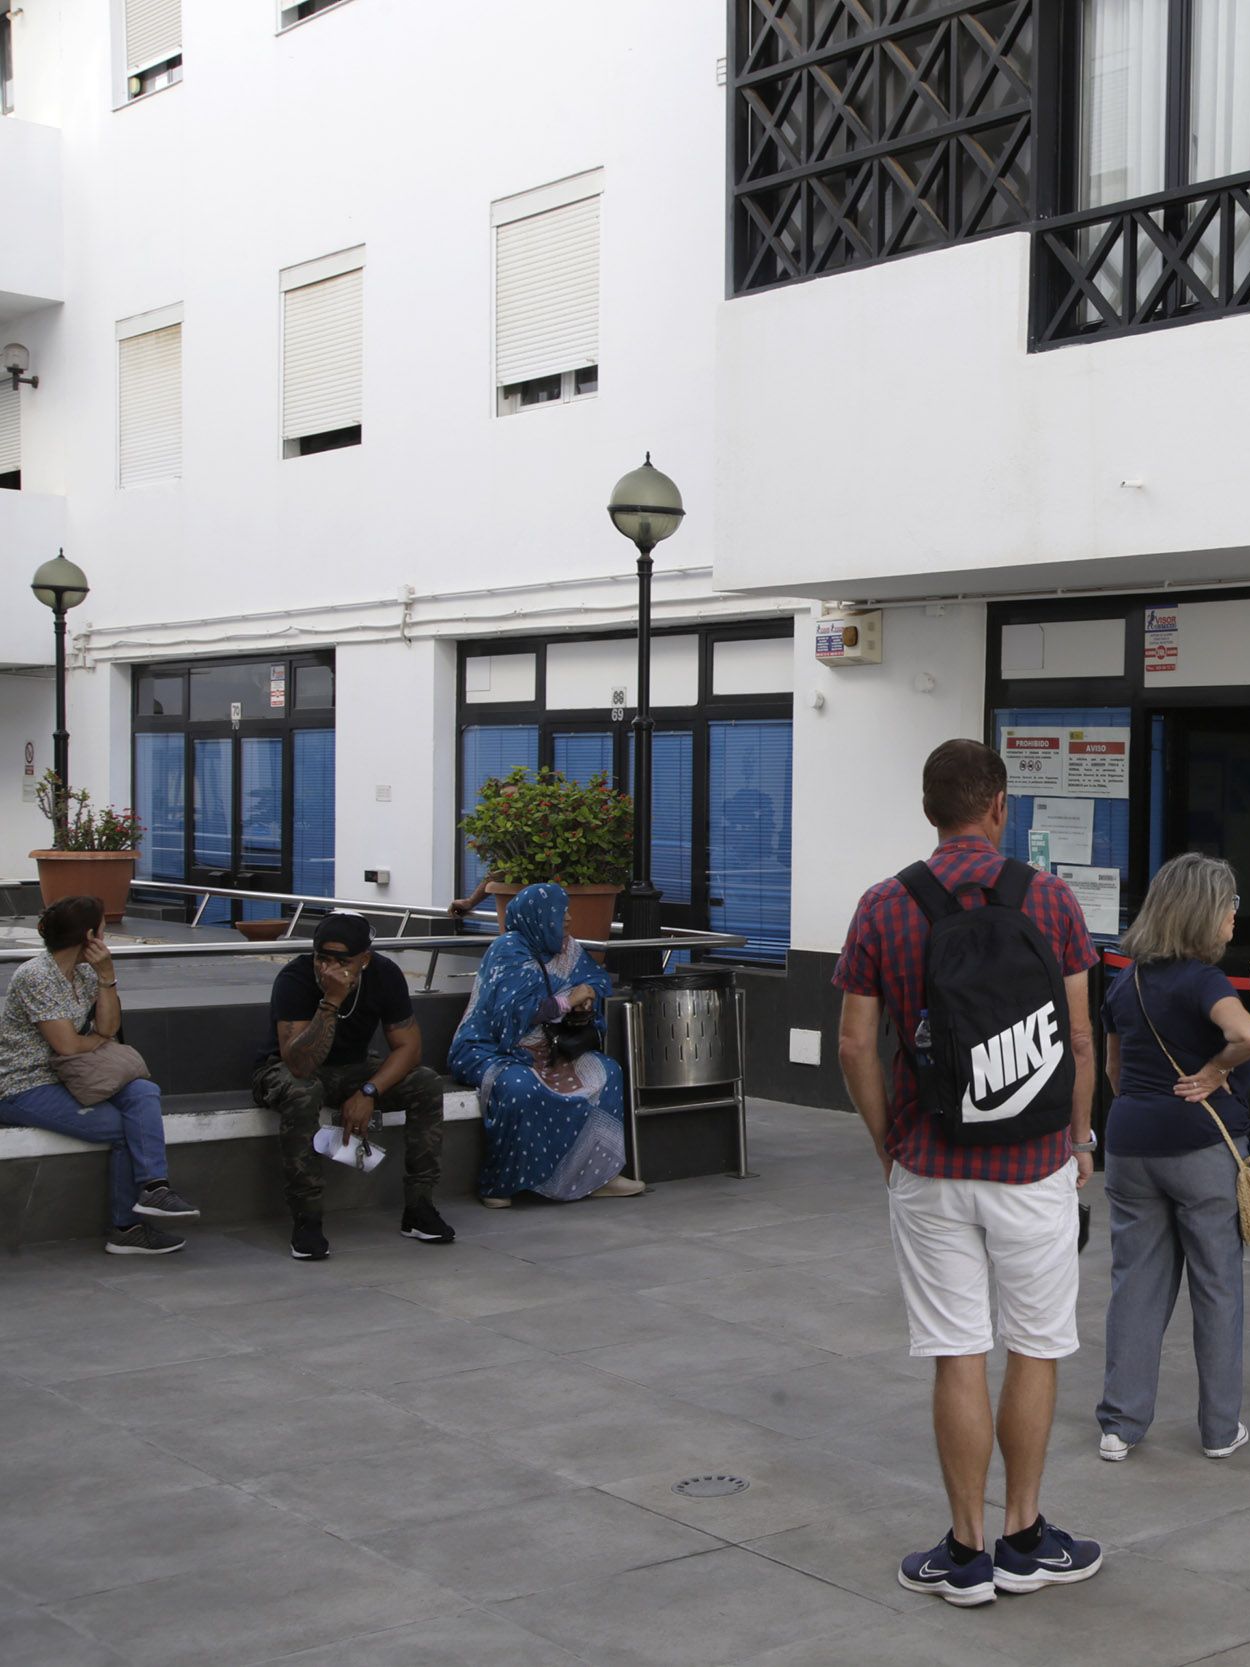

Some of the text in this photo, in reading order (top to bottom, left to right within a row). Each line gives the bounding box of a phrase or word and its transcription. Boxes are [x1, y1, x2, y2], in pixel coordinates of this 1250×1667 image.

[1155, 615, 1177, 625] VISOR
[611, 708, 624, 722] 69
[1015, 740, 1050, 748] PROHIBIDO
[1085, 744, 1107, 753] AVISO
[970, 1000, 1062, 1102] NIKE
